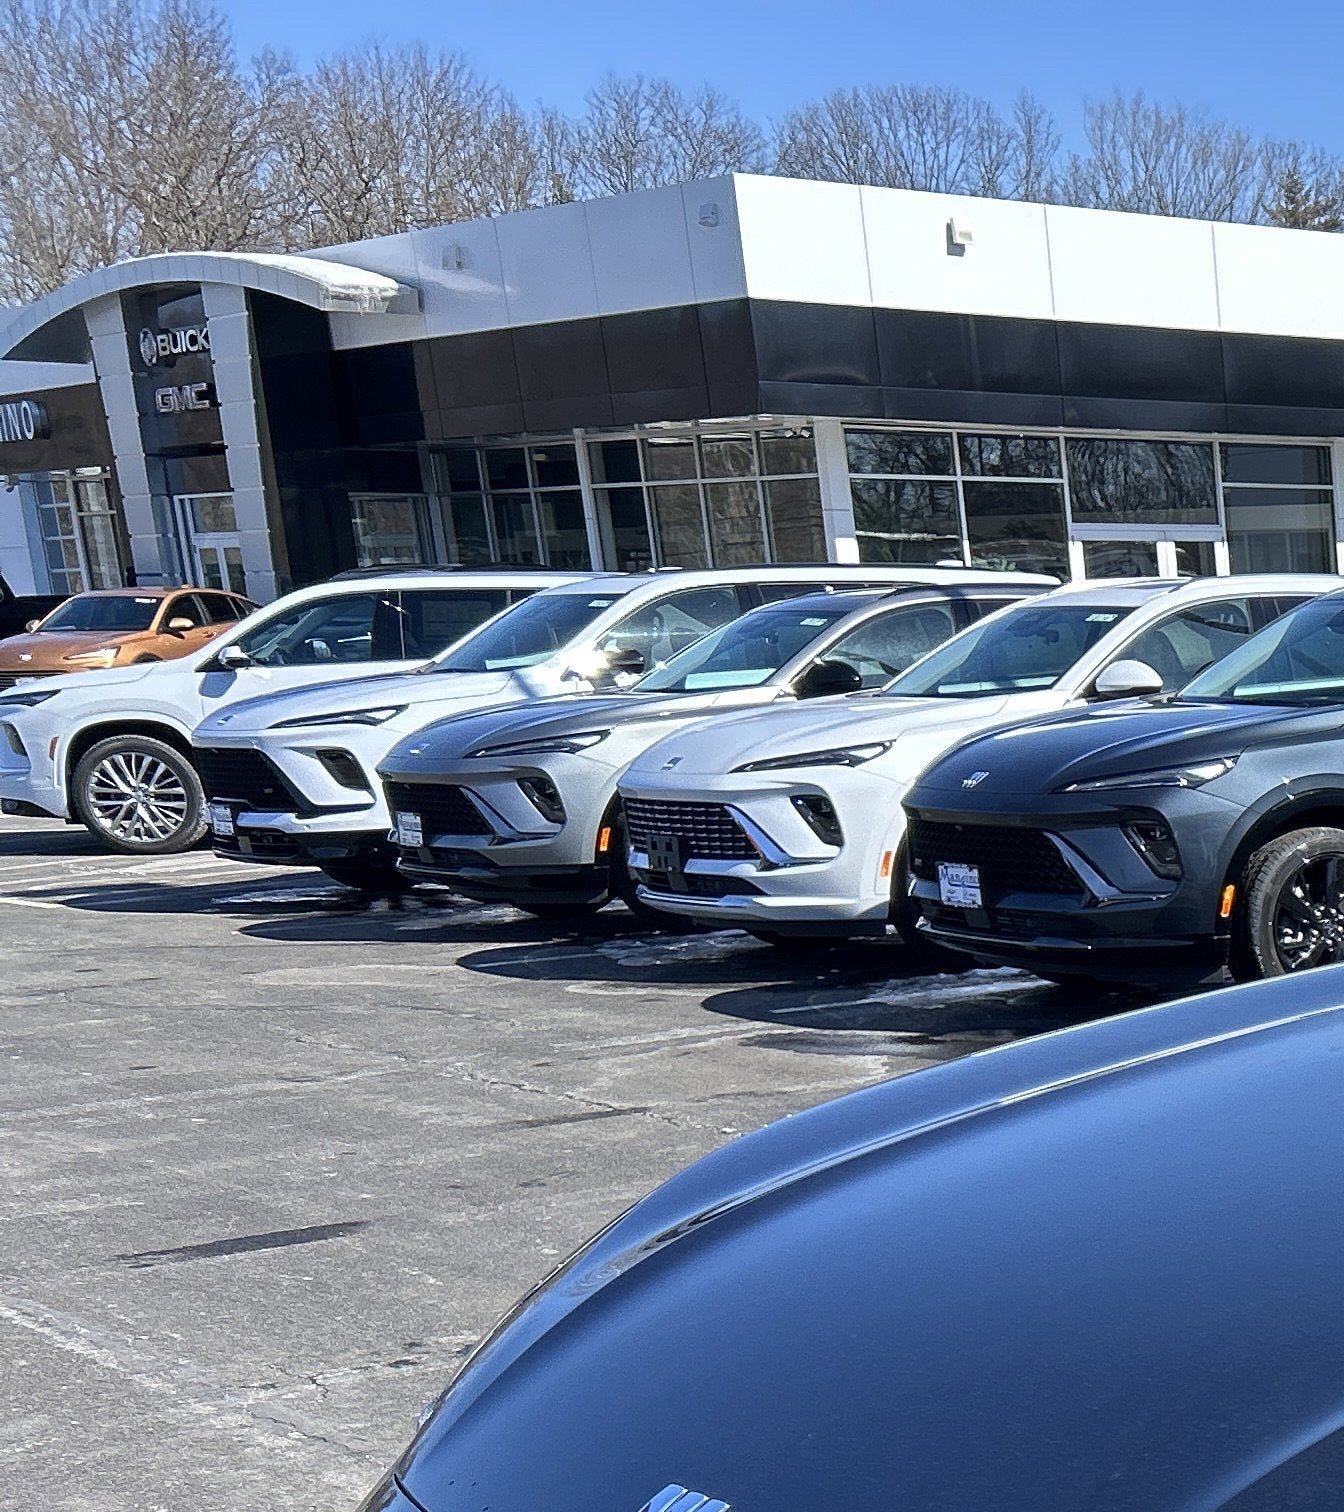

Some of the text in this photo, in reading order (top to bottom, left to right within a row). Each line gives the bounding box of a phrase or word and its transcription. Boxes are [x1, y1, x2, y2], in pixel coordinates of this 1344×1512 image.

[156, 327, 209, 357] BUICK
[156, 382, 210, 413] GMC
[0, 400, 35, 441] INO
